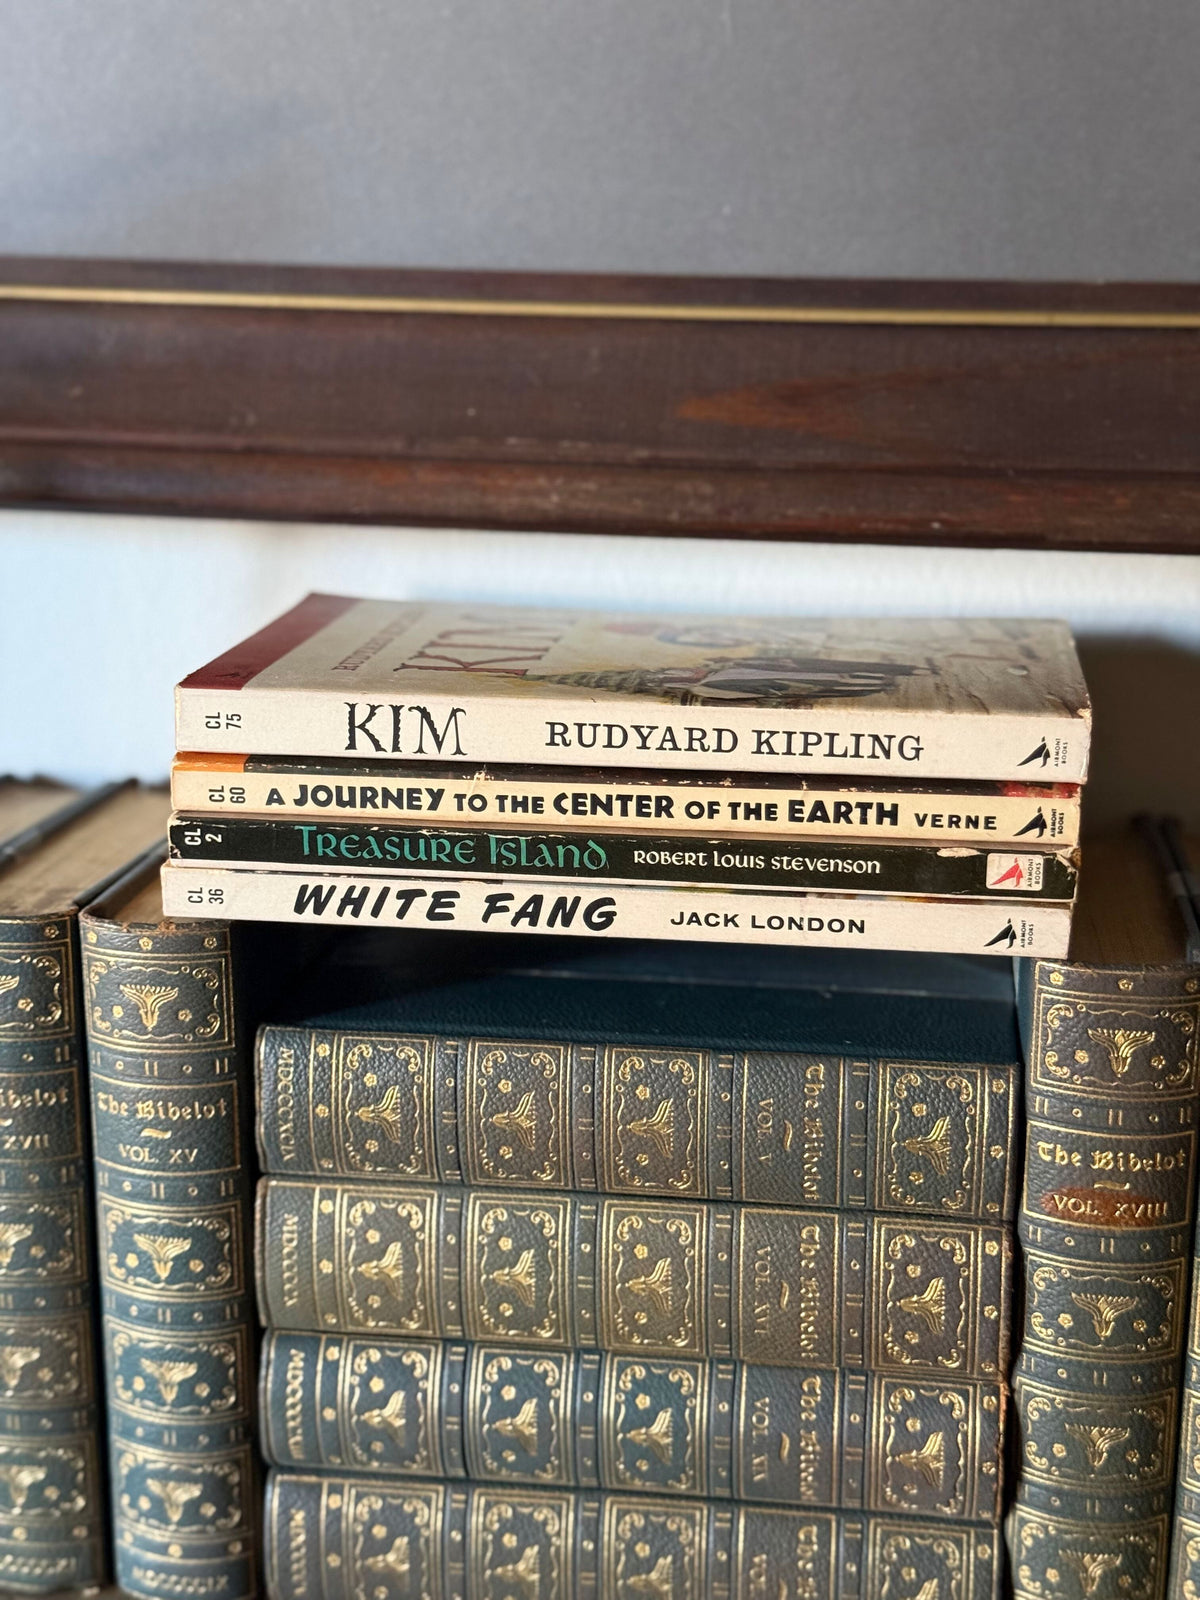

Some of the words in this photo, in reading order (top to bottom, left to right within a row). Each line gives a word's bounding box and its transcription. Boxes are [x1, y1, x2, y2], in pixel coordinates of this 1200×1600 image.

[205, 712, 221, 729] CL
[226, 713, 242, 729] 75
[344, 702, 468, 756] KIM
[545, 722, 739, 753] RUDYARD
[751, 729, 924, 761] KIPLING
[208, 785, 225, 803] CL
[230, 786, 246, 804] 60
[265, 788, 285, 805] A
[293, 784, 445, 811] JOURNEY
[454, 793, 488, 812] TO
[495, 794, 544, 814] THE
[553, 792, 674, 818] CENTER
[685, 801, 721, 819] OF
[728, 802, 778, 821] THE
[788, 800, 899, 826] EARTH
[914, 812, 997, 830] VERNE
[184, 828, 201, 845] CL
[205, 833, 222, 843] 2
[187, 887, 203, 904] CL
[208, 888, 224, 904] 36
[294, 884, 460, 922] WHITE
[482, 892, 617, 931] FANG
[670, 911, 739, 928] JACK
[751, 914, 865, 934] LONDON
[0, 1086, 68, 1109] ibelot
[805, 1063, 824, 1109] The
[97, 1091, 129, 1117] The
[135, 1097, 228, 1121] Bibelot
[757, 1098, 773, 1144] VOL.
[119, 1143, 159, 1164] VOL.
[169, 1147, 198, 1164] XV
[759, 1152, 773, 1166] V
[803, 1116, 824, 1200] Bibelot
[1037, 1140, 1082, 1168] The
[1090, 1148, 1186, 1172] Bibelot
[1053, 1194, 1102, 1216] VOL.
[1115, 1202, 1168, 1218] XVIII
[800, 1225, 820, 1269] The
[800, 1276, 820, 1358] Bibelot
[801, 1375, 821, 1422] The
